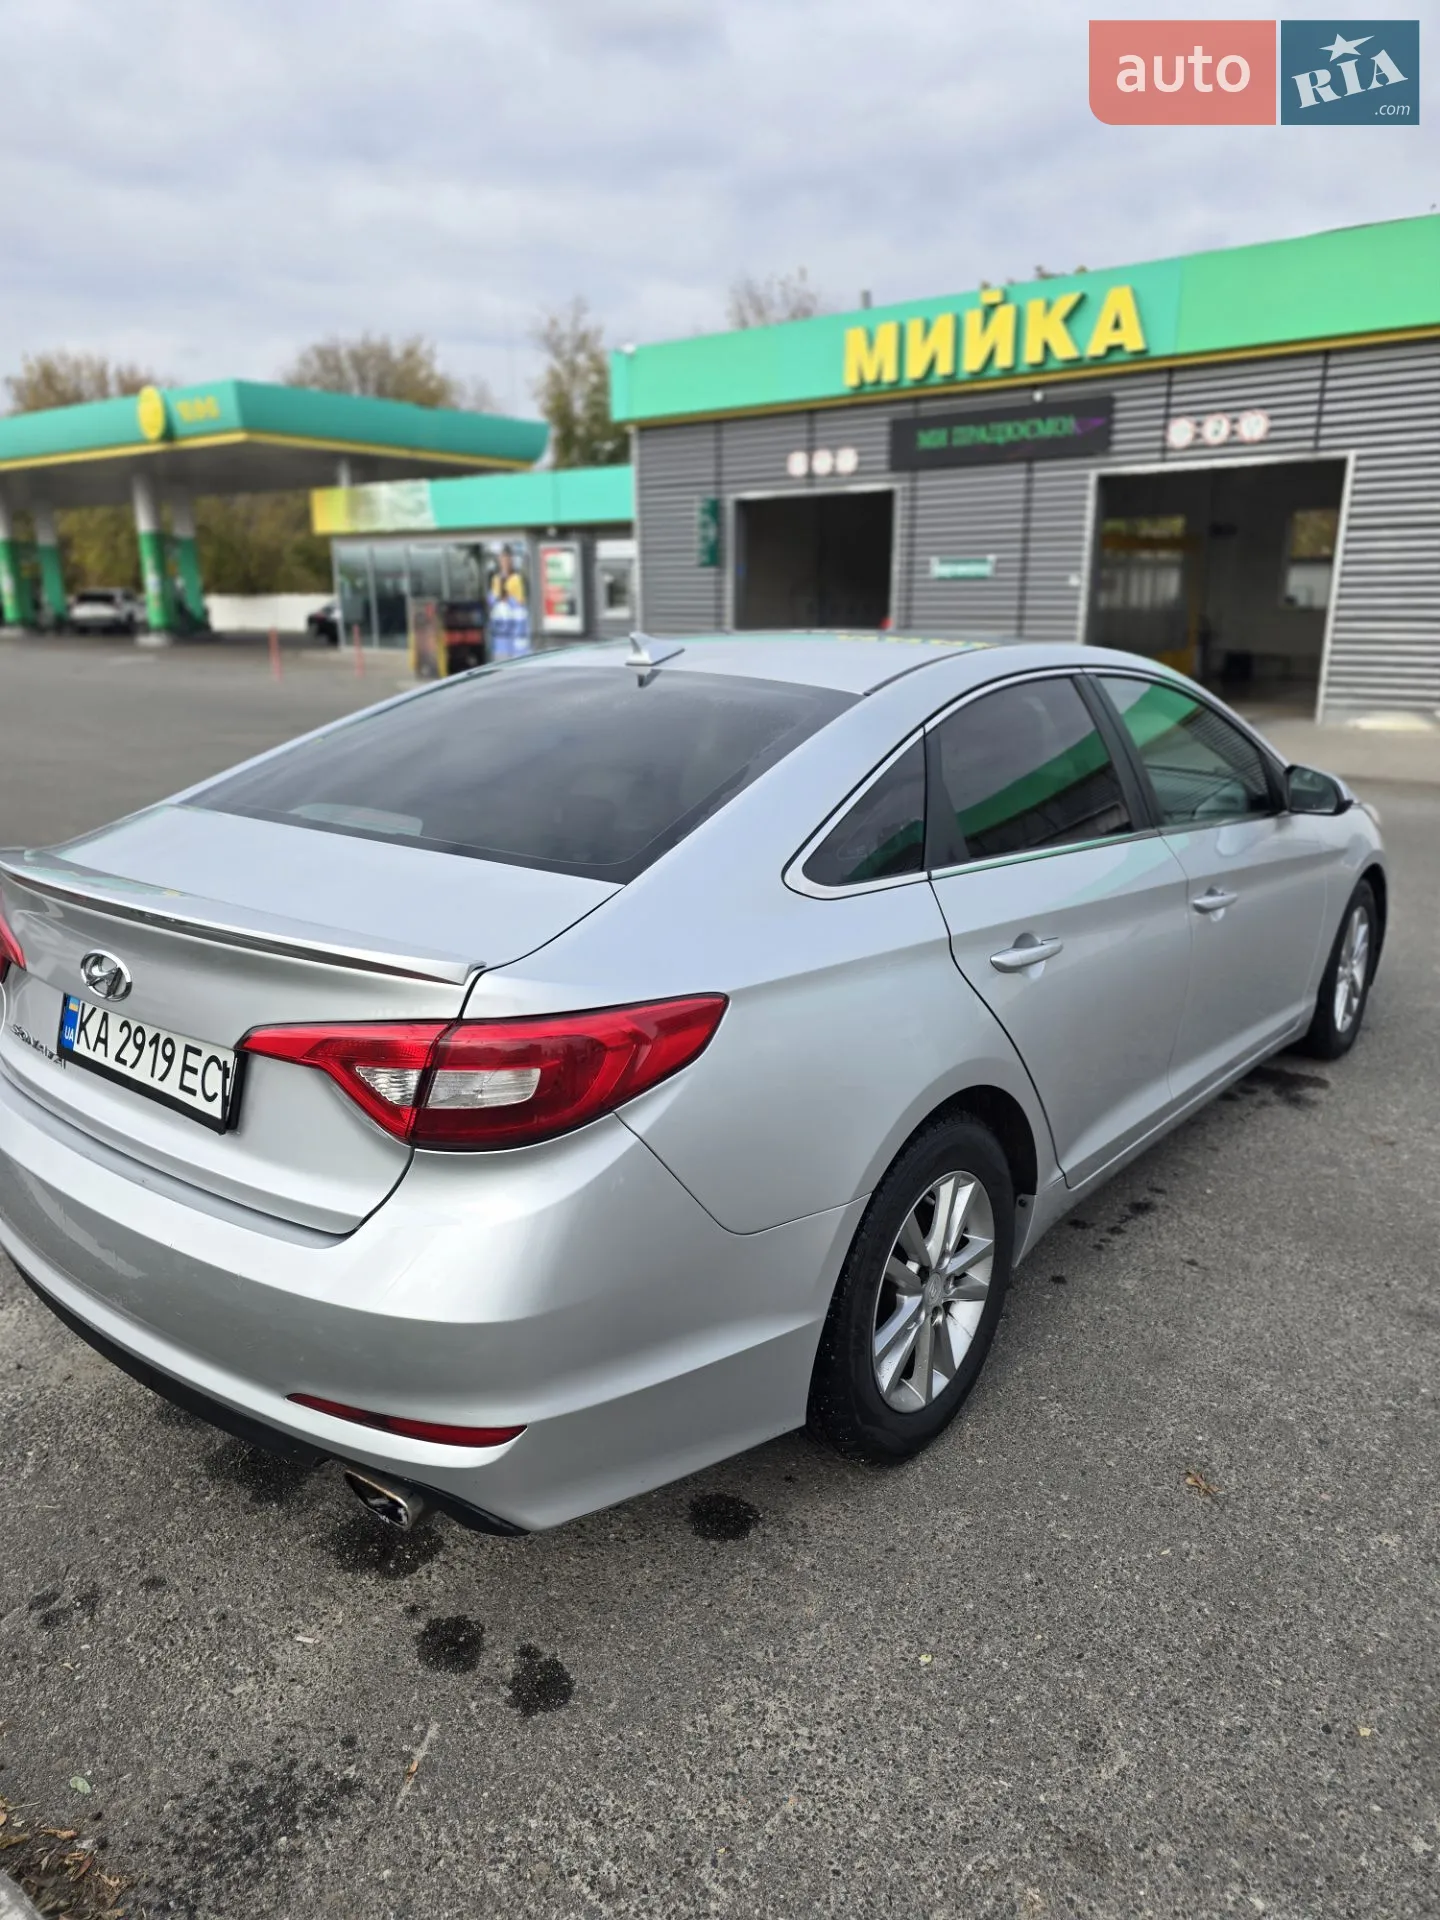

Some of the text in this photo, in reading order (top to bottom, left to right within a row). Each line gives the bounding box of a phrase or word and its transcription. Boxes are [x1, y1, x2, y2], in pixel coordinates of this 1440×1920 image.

[844, 285, 1147, 389] МИЙКА
[64, 1025, 74, 1042] UA
[77, 1002, 223, 1103] KA 2919 EC
